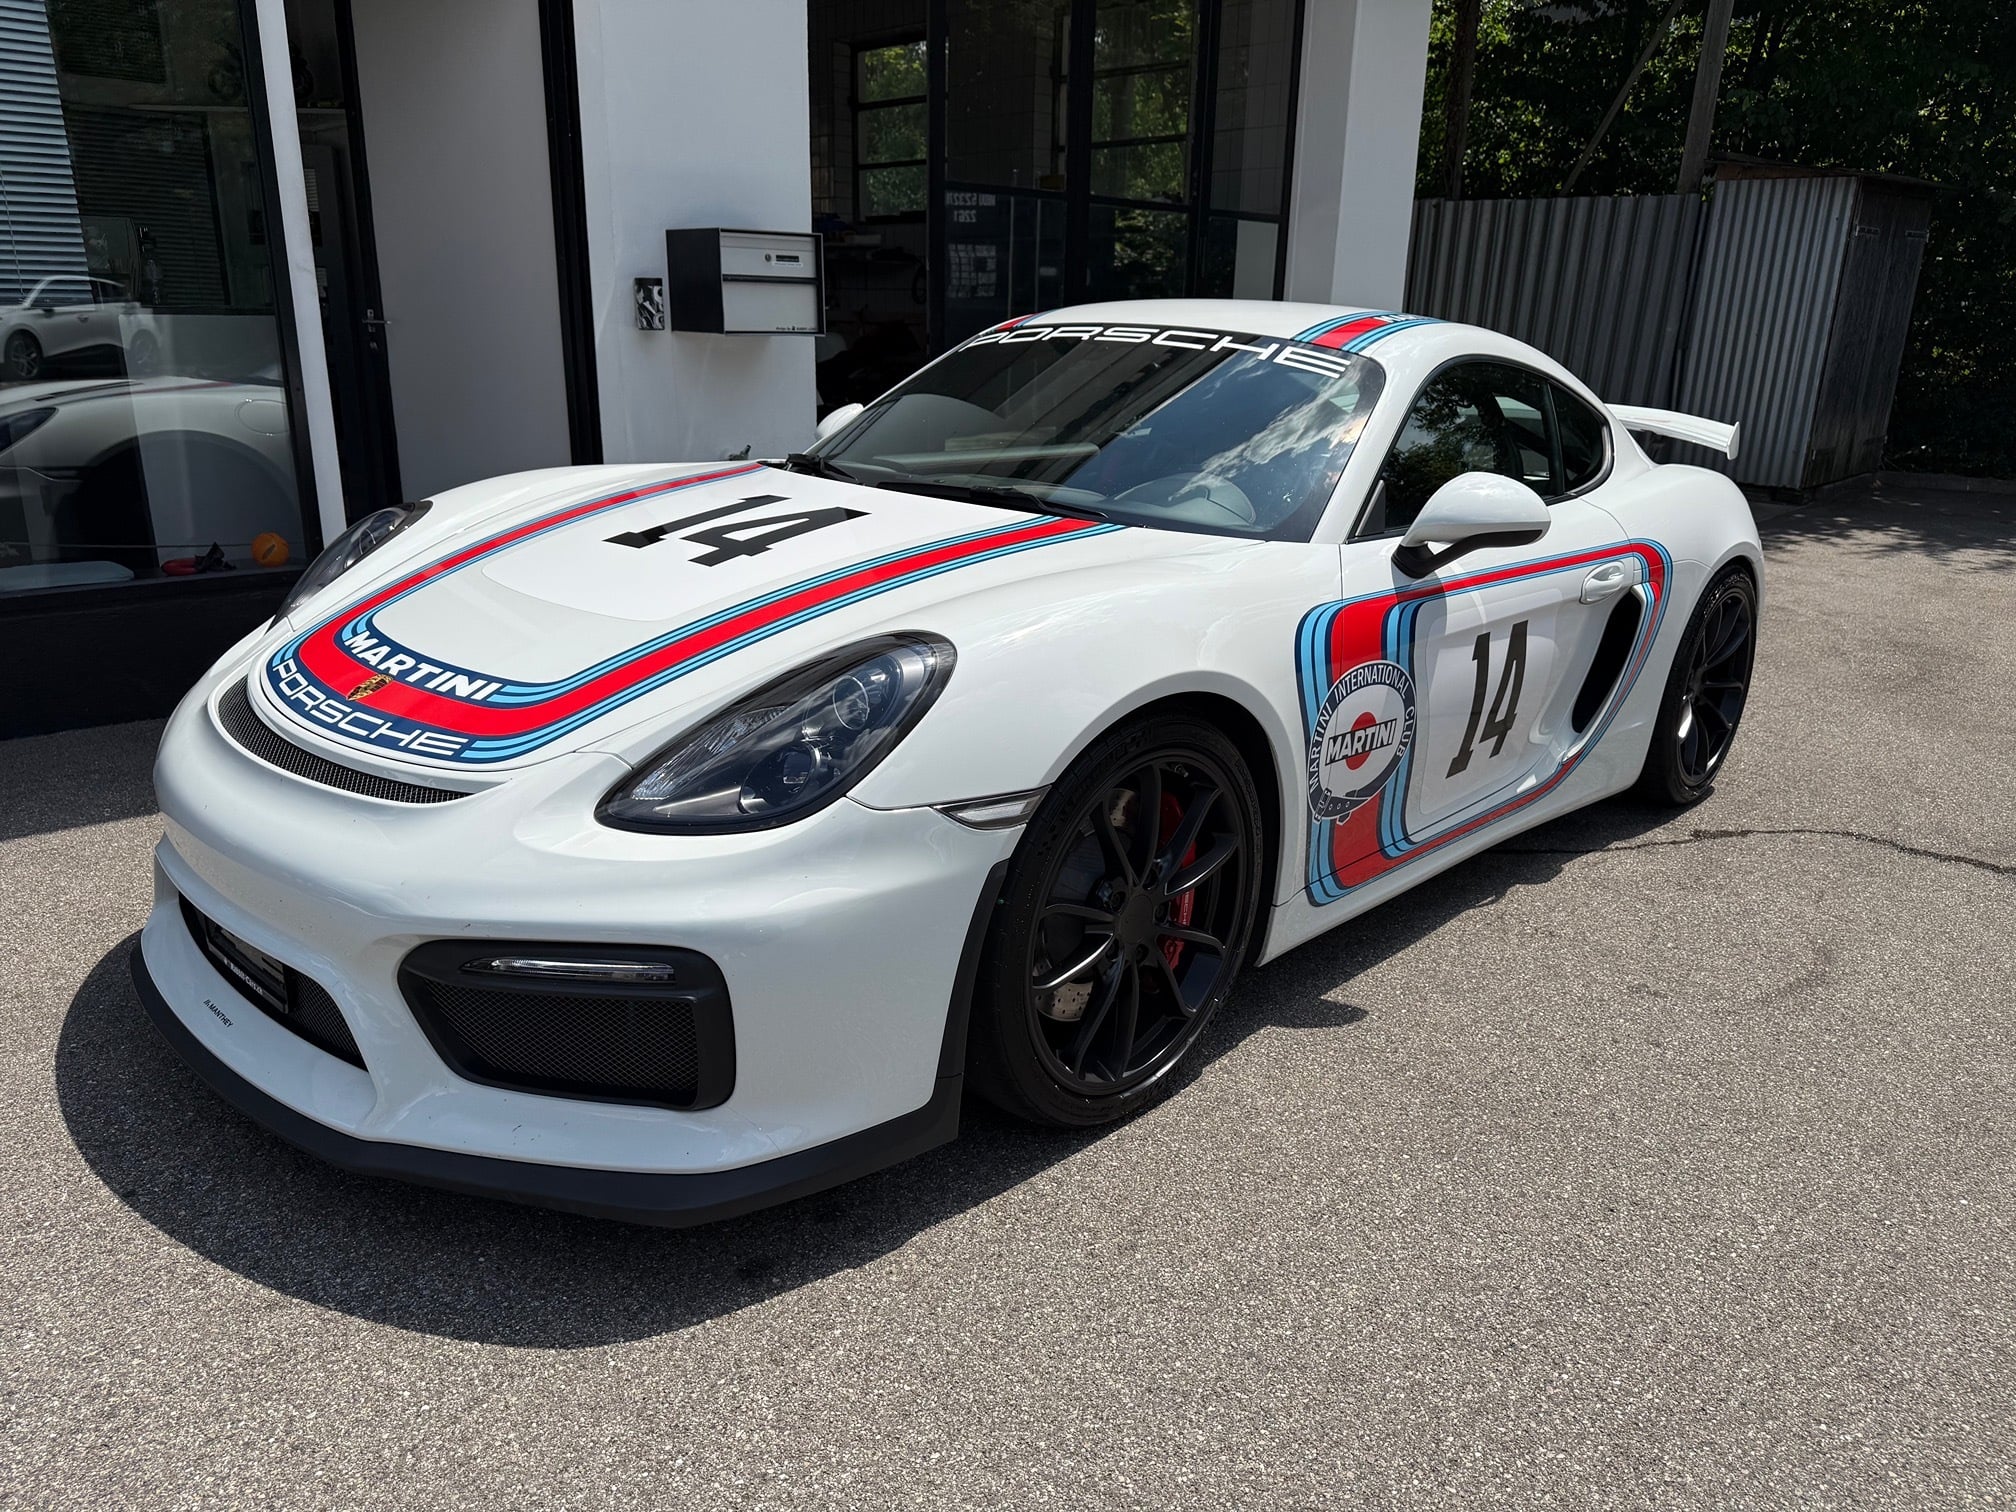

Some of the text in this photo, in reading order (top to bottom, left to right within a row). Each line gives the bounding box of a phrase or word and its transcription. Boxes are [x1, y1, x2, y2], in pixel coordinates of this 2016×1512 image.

[958, 326, 1351, 379] PORSCHE
[601, 494, 872, 567] 14
[344, 630, 502, 700] MARTINI
[1445, 620, 1528, 779] 14
[272, 658, 468, 755] PORSCHE
[1308, 664, 1415, 793] MARTINI INTERNATIONAL CLUB
[1325, 719, 1398, 765] MARTINI
[207, 1003, 234, 1028] MANTHEY
